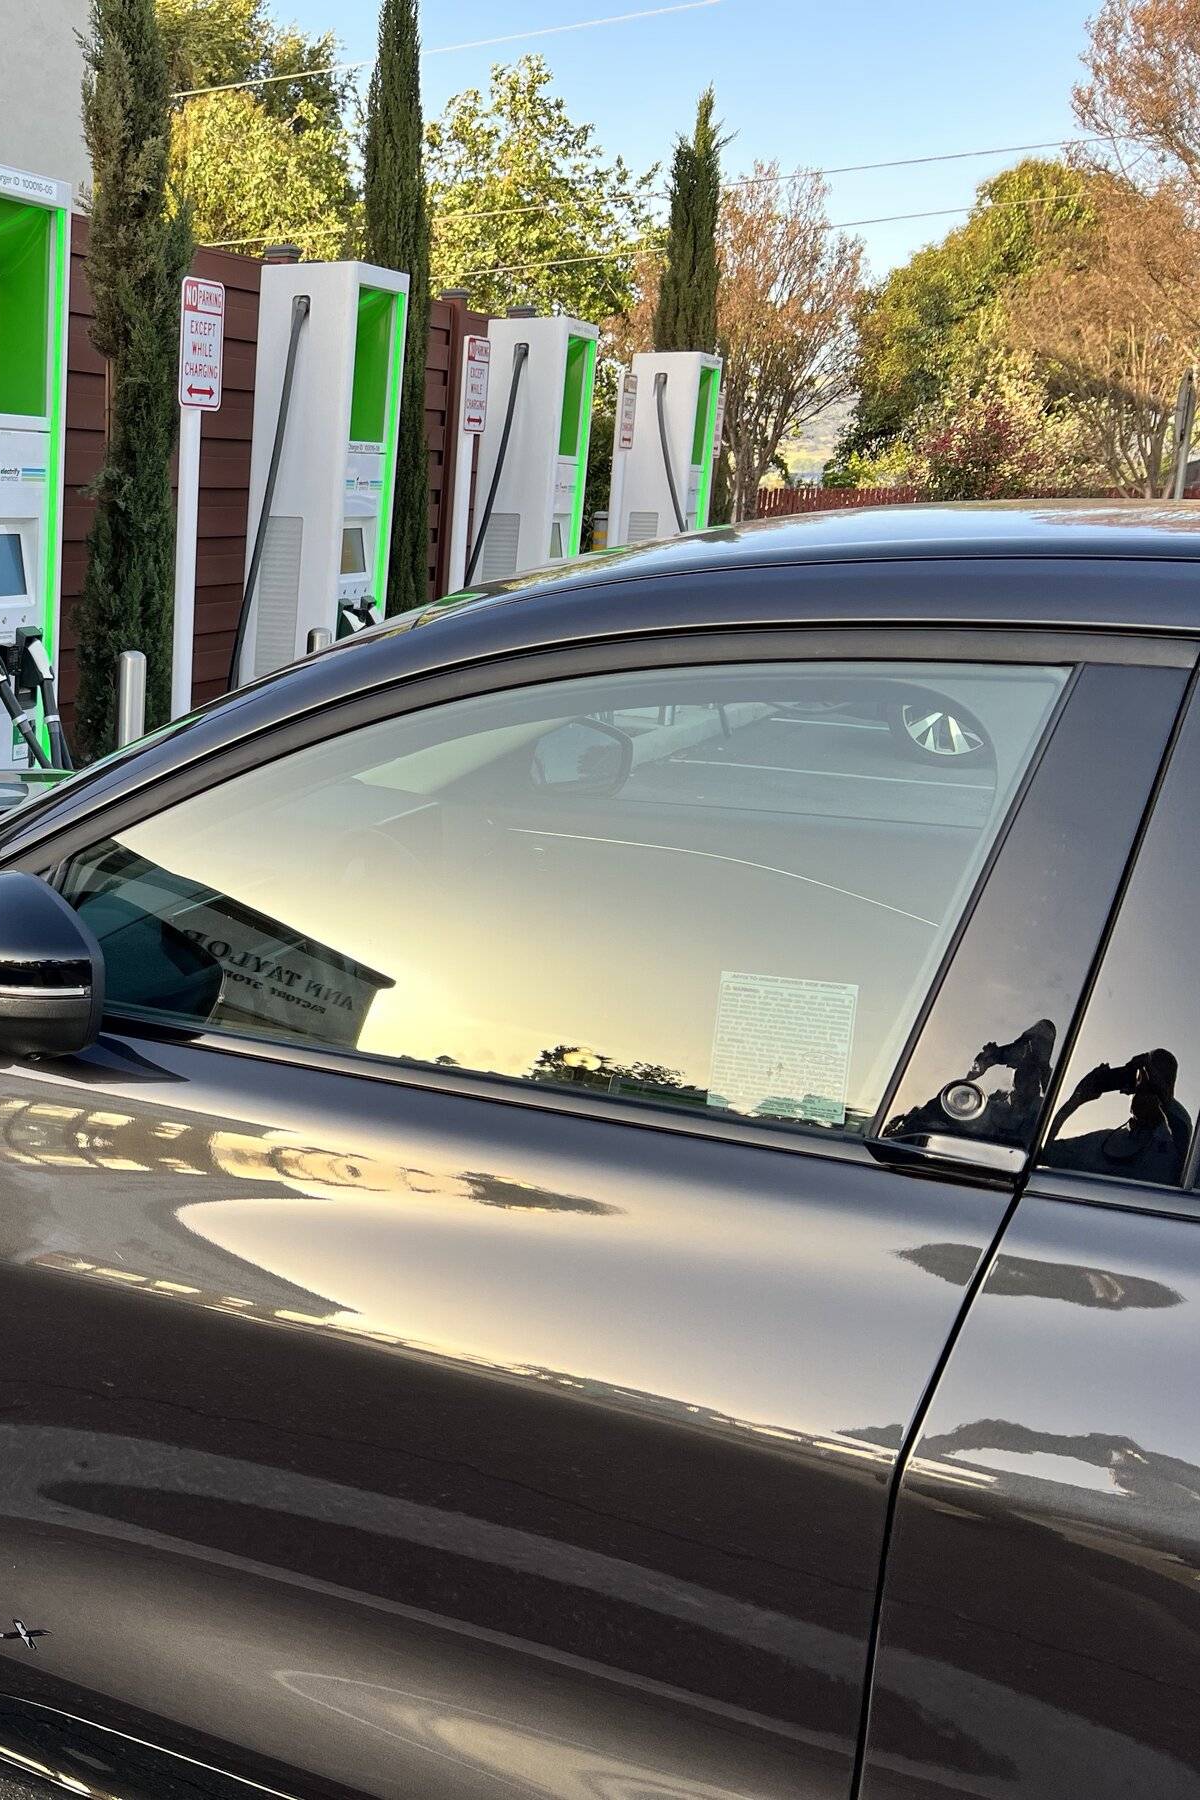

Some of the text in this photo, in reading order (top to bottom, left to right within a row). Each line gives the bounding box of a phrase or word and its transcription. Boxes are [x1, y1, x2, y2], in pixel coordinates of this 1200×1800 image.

[13, 177, 20, 186] ID
[186, 285, 222, 308] NO PARKING
[190, 320, 216, 337] EXCEPT
[192, 341, 213, 358] WHILE
[184, 362, 218, 380] CHARGING
